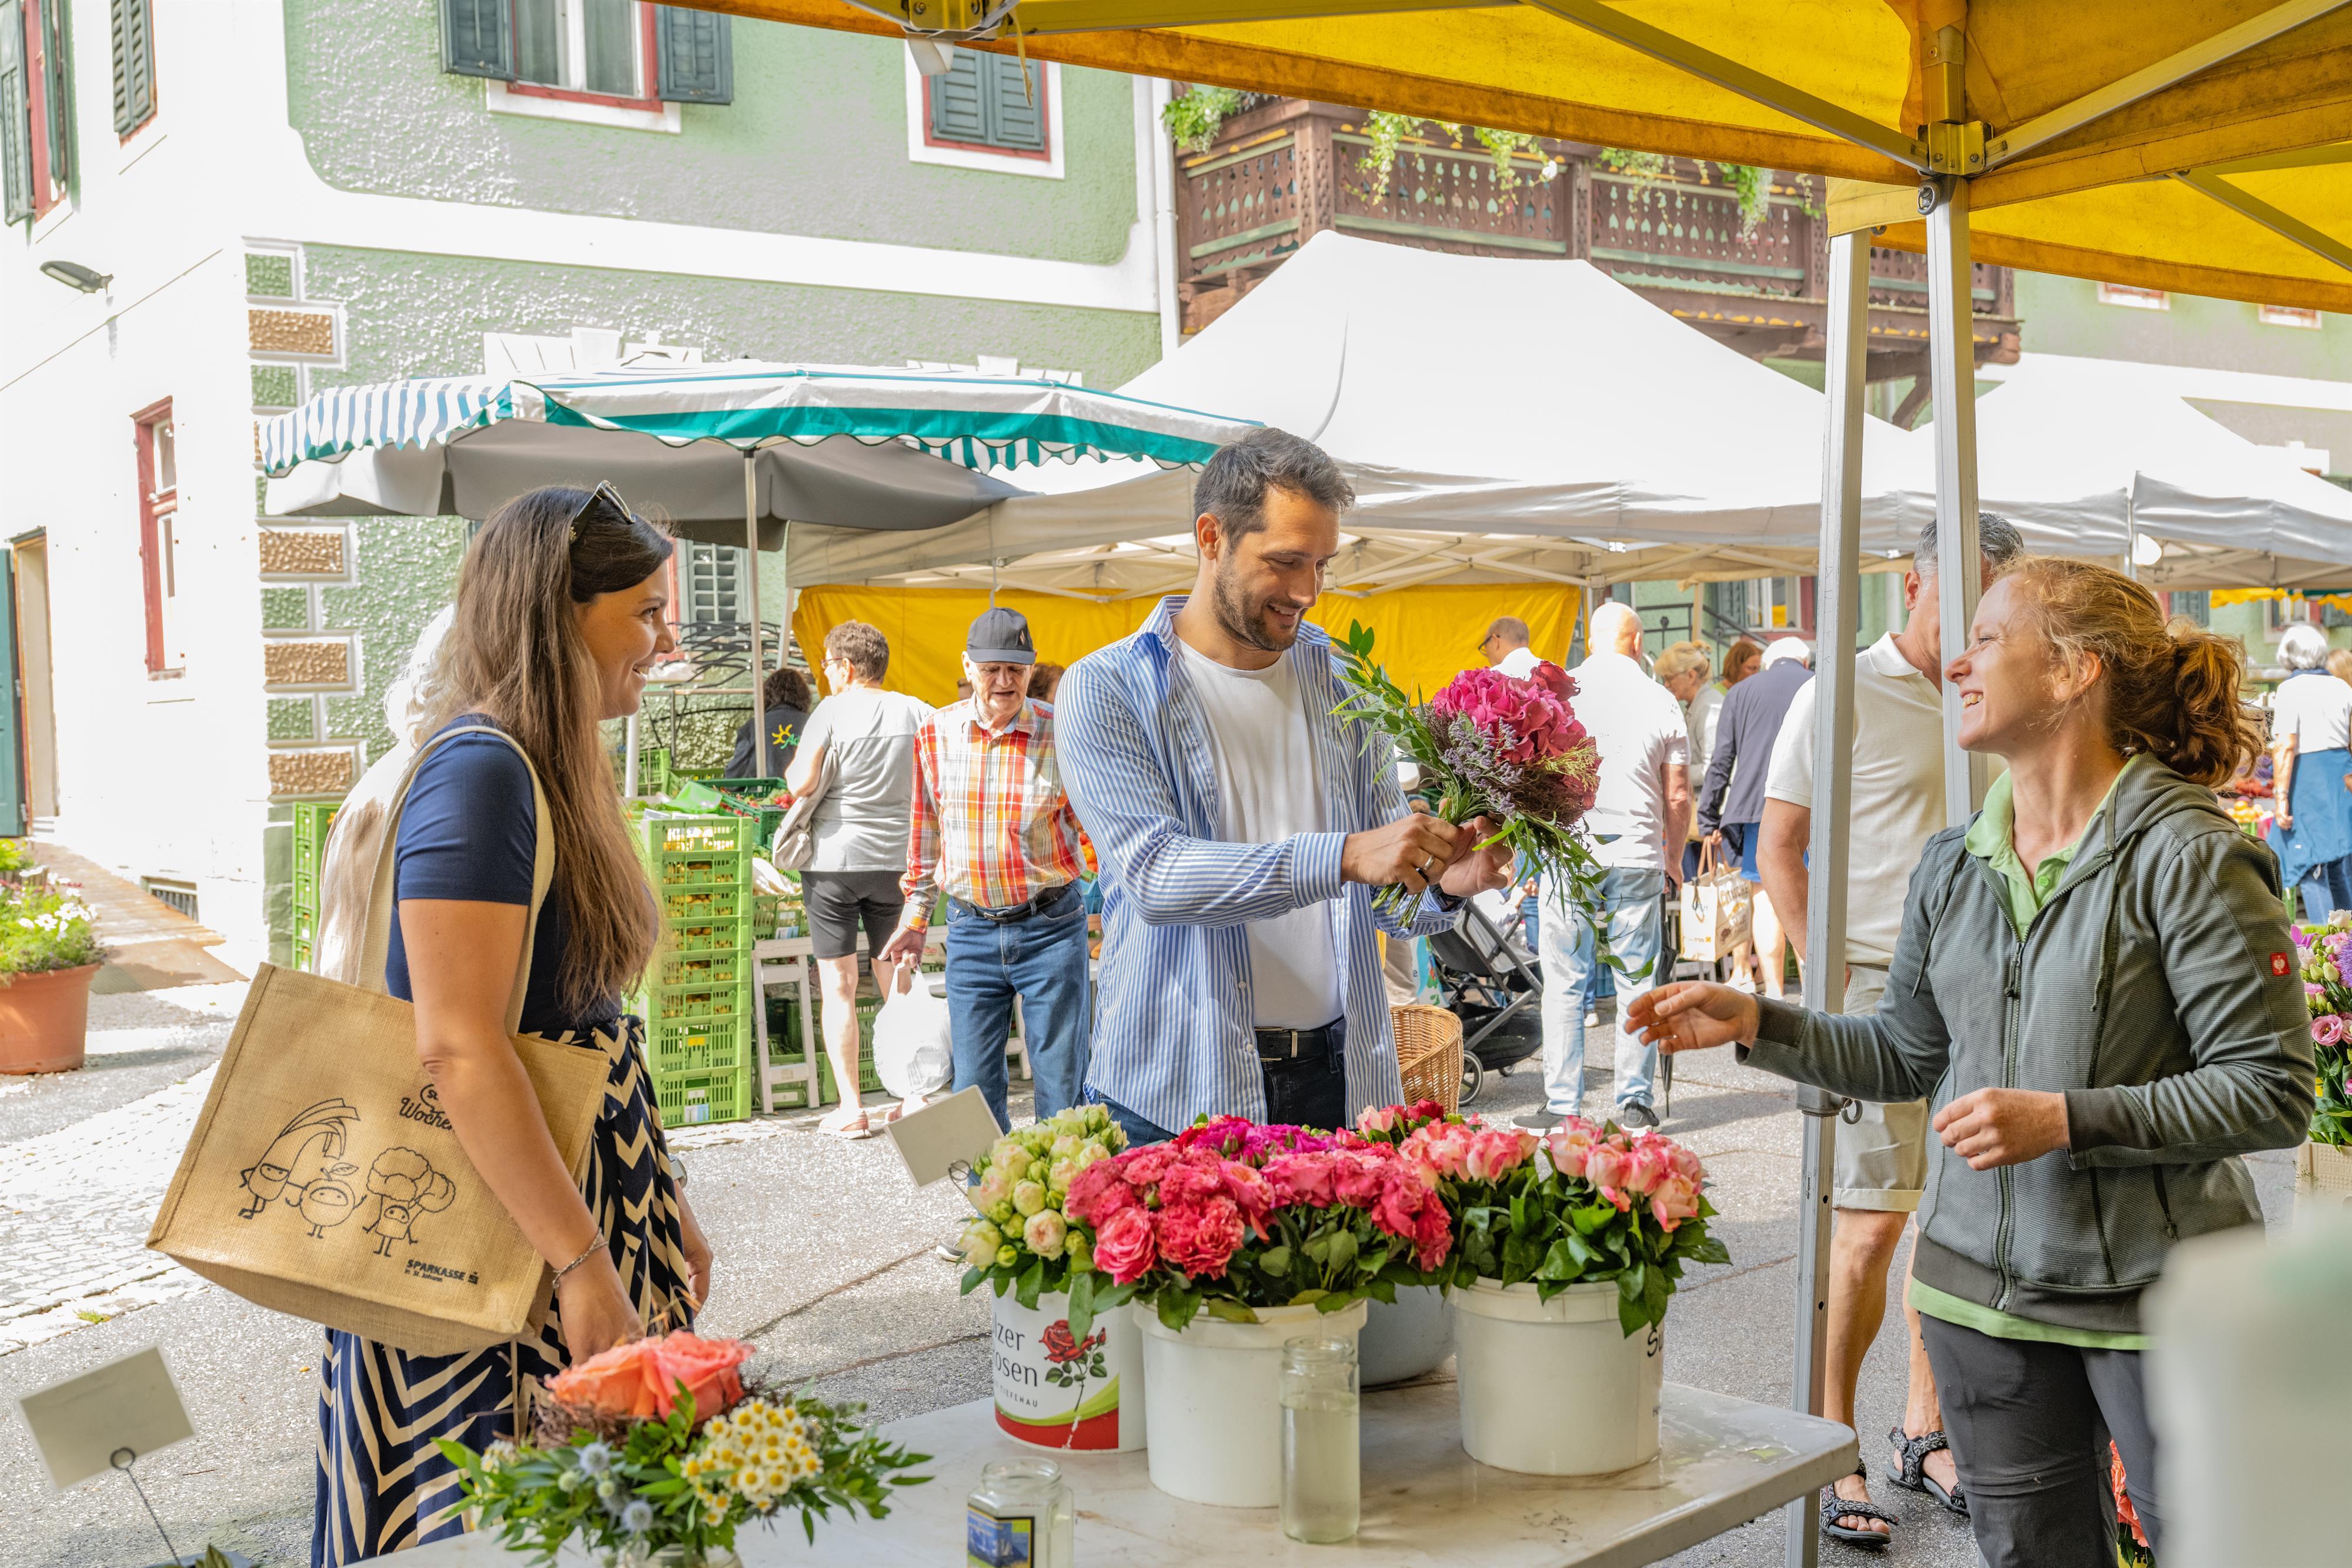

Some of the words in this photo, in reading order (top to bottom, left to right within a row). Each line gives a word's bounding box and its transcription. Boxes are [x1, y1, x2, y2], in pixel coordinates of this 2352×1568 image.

[399, 1097, 453, 1131] Woche
[406, 1259, 466, 1281] SPARKASSE
[993, 1312, 1025, 1351] lzer
[994, 1349, 1037, 1387] osen
